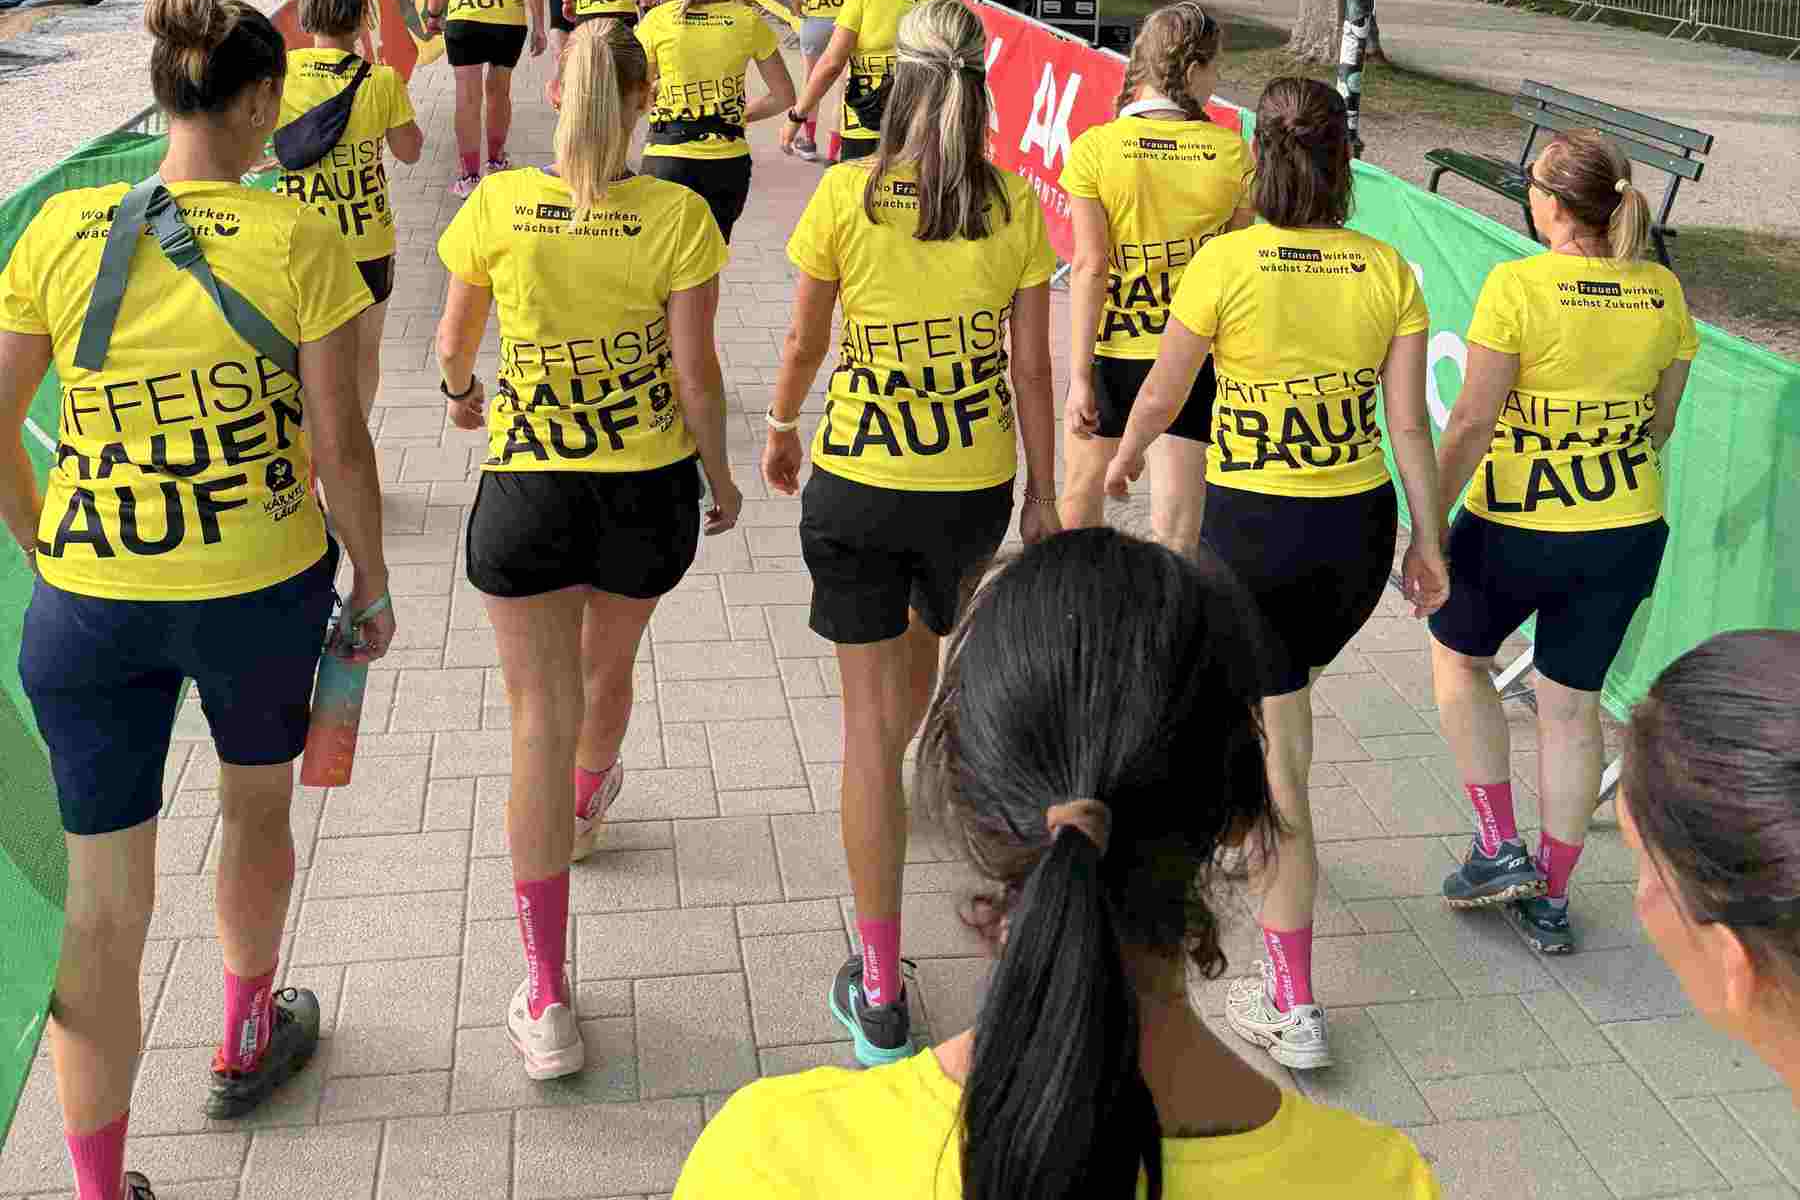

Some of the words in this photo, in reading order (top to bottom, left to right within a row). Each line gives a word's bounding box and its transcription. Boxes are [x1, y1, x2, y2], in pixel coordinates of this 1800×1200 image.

[514, 204, 534, 216] Wo
[539, 205, 577, 220] Frau
[592, 211, 642, 223] wirken,
[76, 227, 111, 241] wäc
[512, 222, 560, 235] wächst
[1557, 282, 1576, 292] Wo
[1578, 281, 1620, 296] Frauen
[1560, 297, 1600, 308] wächst
[61, 354, 302, 436] IFFEISE
[821, 388, 990, 457] LAUF
[1485, 448, 1649, 513] LAUF
